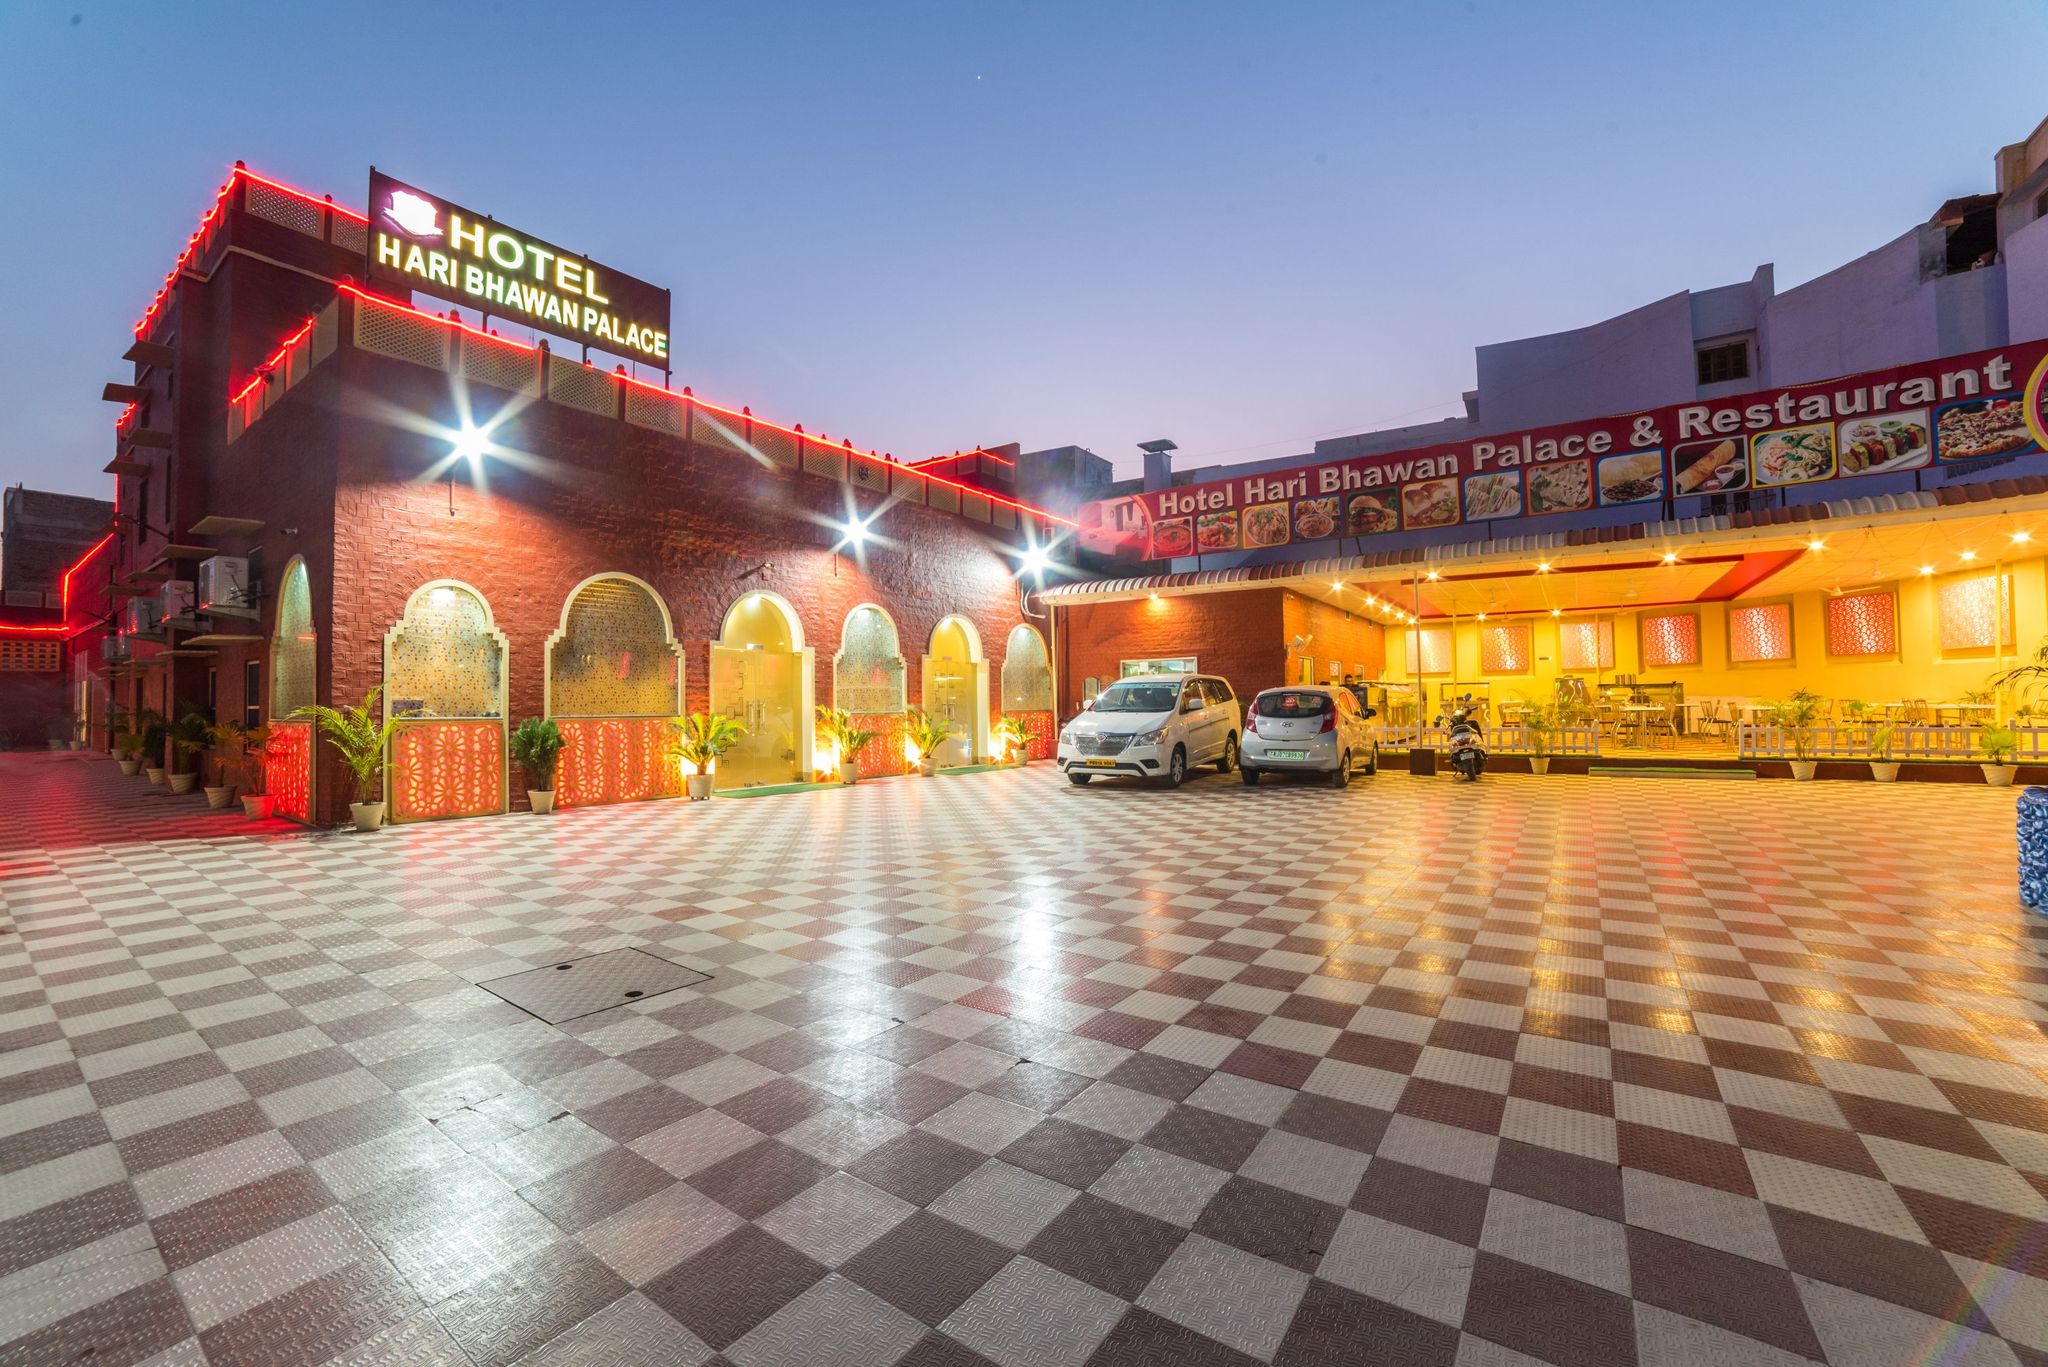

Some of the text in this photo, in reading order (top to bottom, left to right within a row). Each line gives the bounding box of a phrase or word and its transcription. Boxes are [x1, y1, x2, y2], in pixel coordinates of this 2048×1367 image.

[378, 233, 668, 358] HARI BHAWAN PALACE
[450, 214, 609, 305] HOTEL
[1158, 354, 2015, 517] Hotel Hari Bhawan Palace & Restaurant
